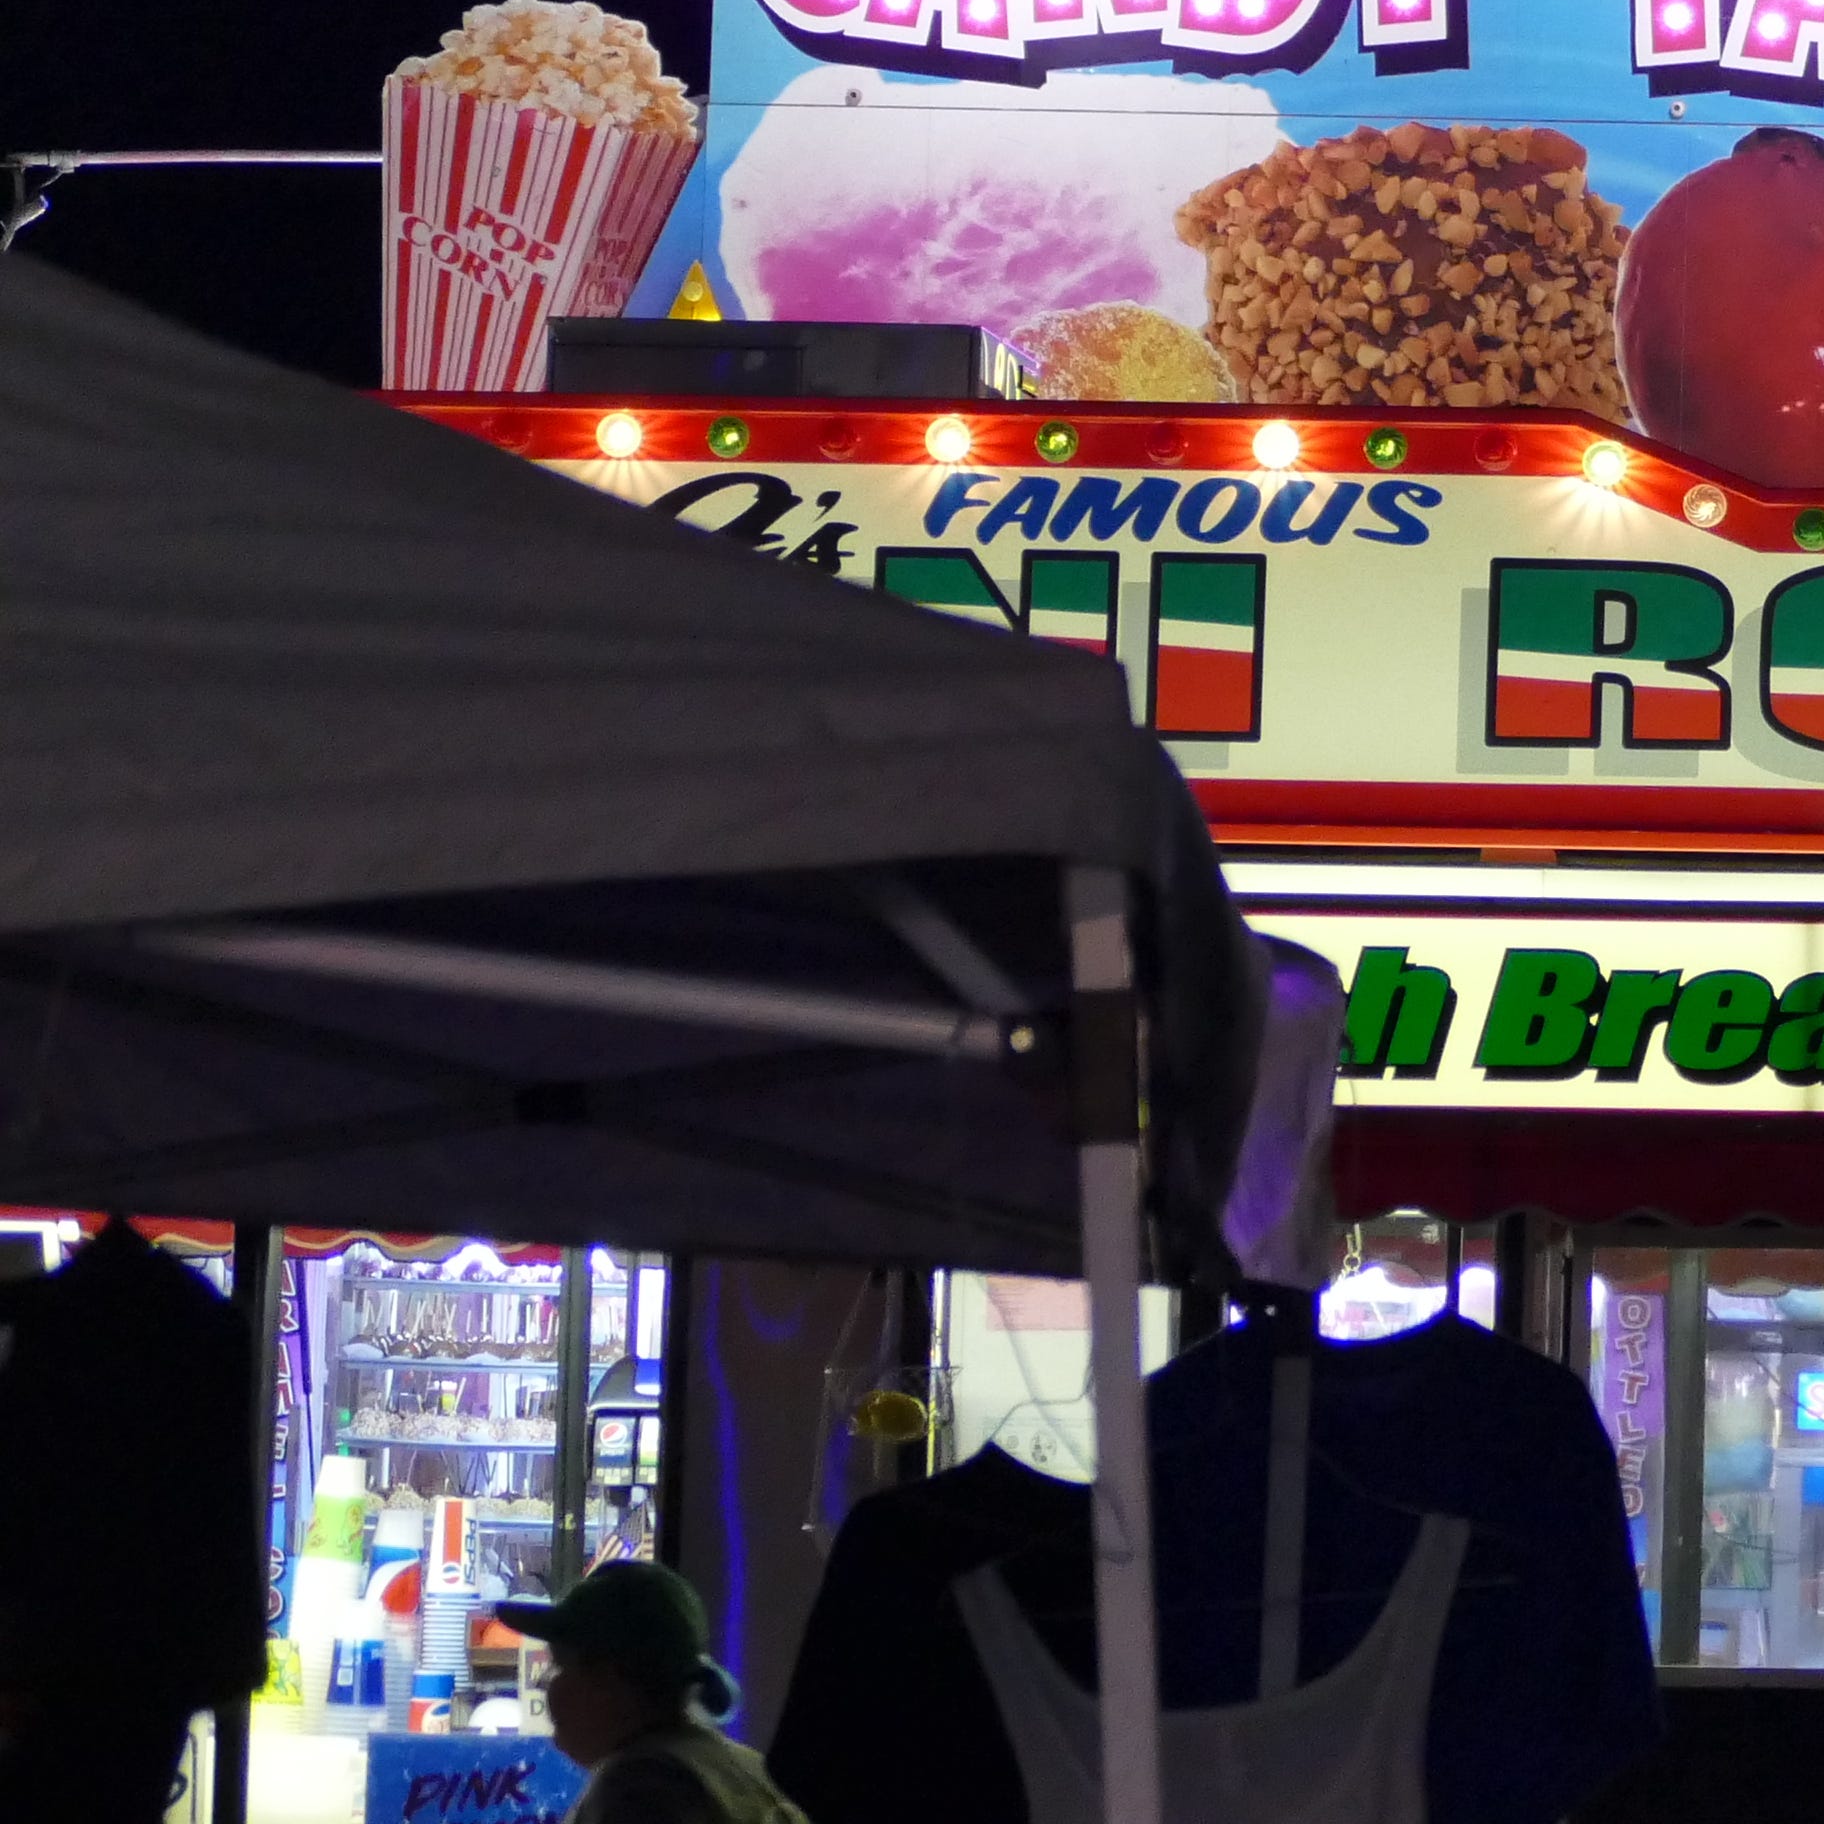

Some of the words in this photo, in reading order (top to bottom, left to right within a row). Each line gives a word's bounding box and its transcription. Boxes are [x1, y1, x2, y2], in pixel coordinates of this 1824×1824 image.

[402, 214, 520, 302] CORN
[465, 206, 556, 267] POP
[922, 471, 1444, 547] FAMOUS
[402, 1762, 537, 1819] PINK
